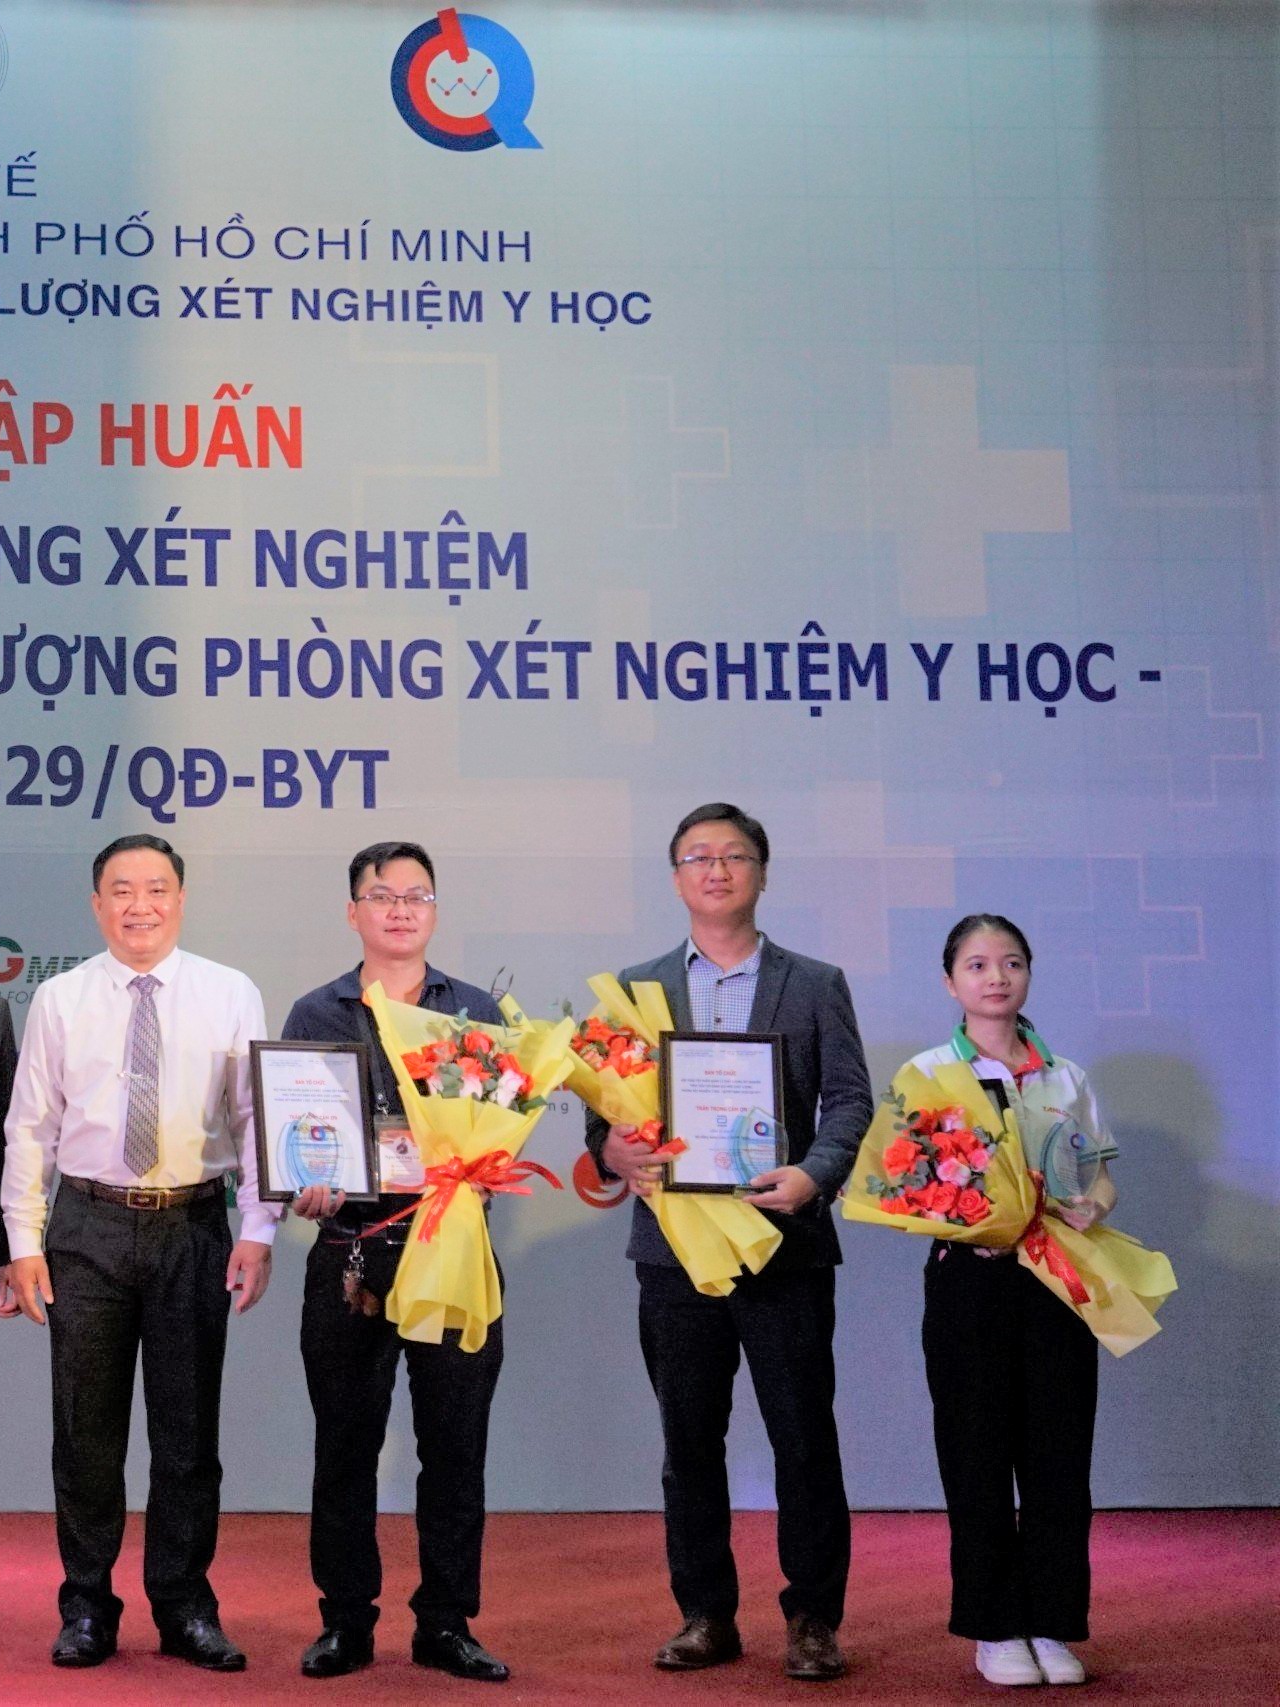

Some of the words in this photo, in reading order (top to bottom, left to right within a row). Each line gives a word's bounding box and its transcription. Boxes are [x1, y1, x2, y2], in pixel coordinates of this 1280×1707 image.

[36, 211, 154, 257] PHỐ
[175, 213, 255, 259] HỒ
[274, 219, 370, 260] CHÍ
[392, 229, 530, 262] MINH
[180, 277, 273, 320] XÉT
[293, 280, 485, 331] NGHIỆM
[502, 291, 531, 324] Y
[551, 291, 651, 331] HỌC
[100, 383, 302, 470] HUẤN
[105, 507, 231, 587] XÉT
[255, 510, 528, 605] NGHIỆM
[205, 617, 443, 700] PHÒNG
[467, 619, 591, 700] XÉT
[616, 621, 888, 717] NGHIỆM
[910, 643, 953, 701] Y
[977, 642, 1116, 718] HỌC
